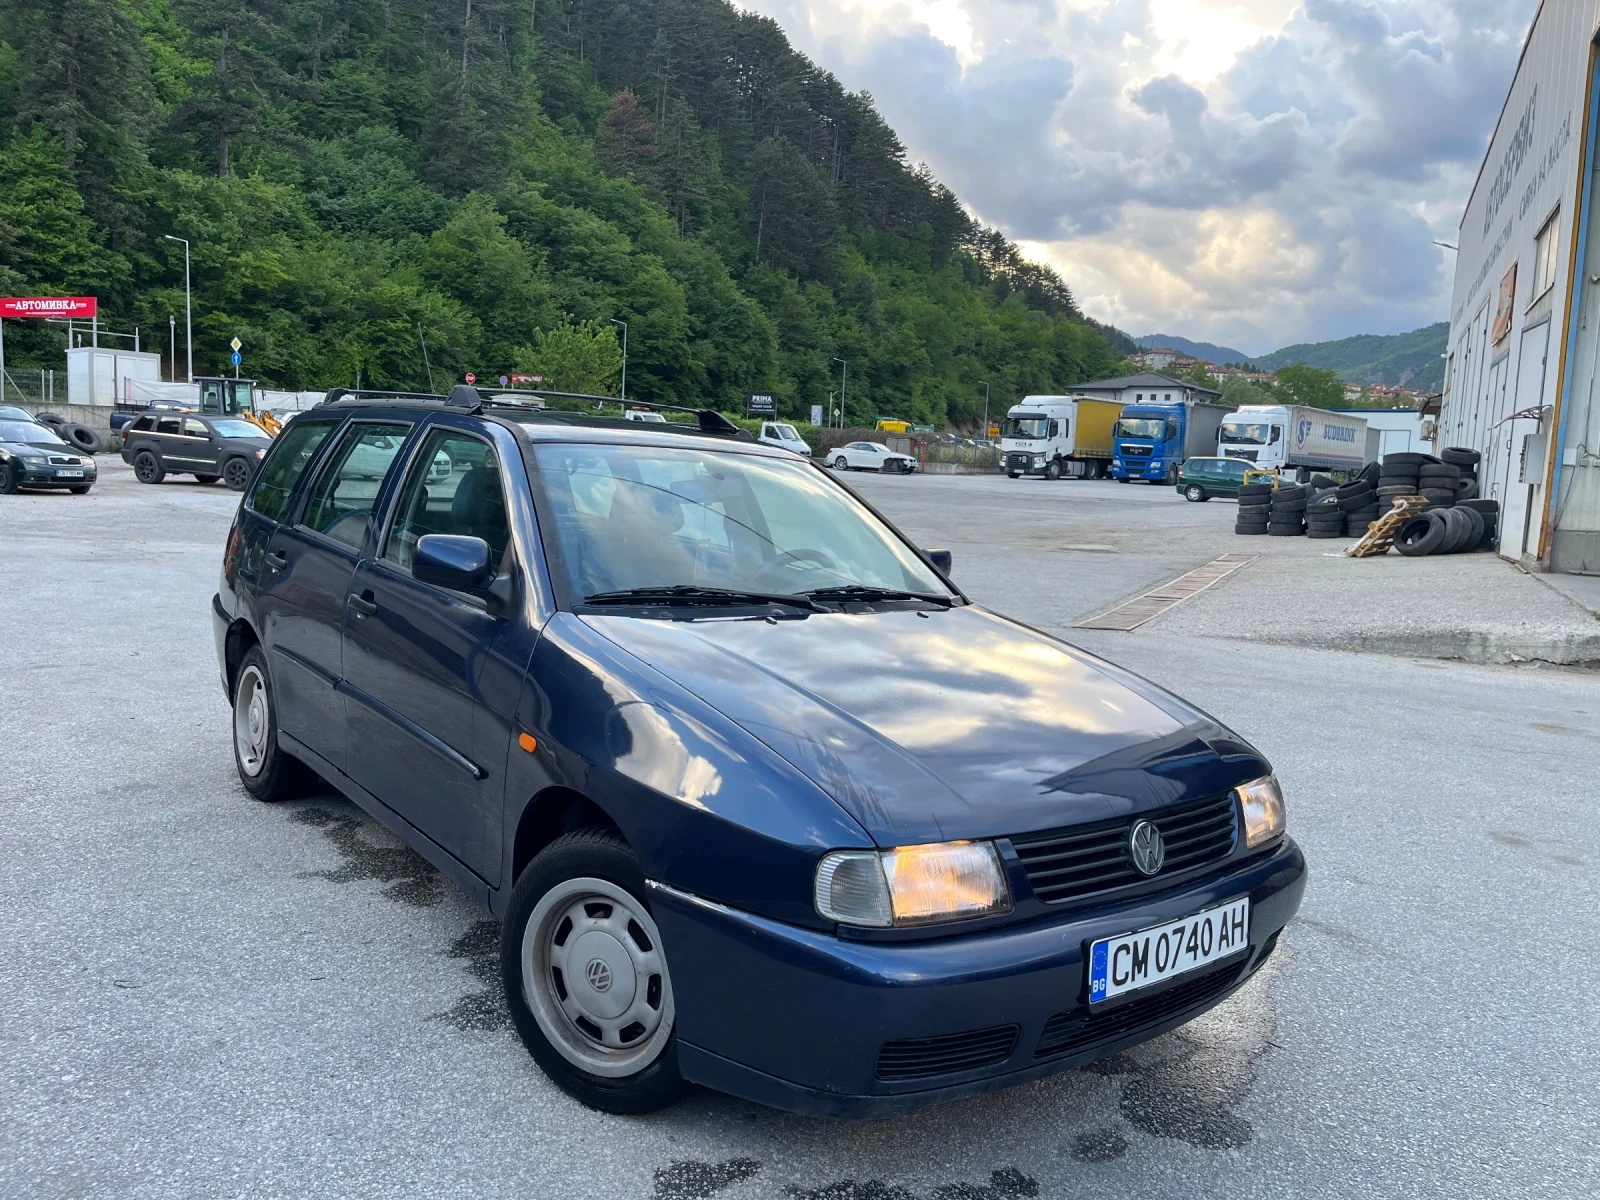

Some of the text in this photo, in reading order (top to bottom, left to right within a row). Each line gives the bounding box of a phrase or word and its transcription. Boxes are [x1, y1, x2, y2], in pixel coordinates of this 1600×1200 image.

[15, 300, 76, 310] АВТОМИВКА
[1112, 904, 1245, 987] CM 0740 AH
[1092, 977, 1106, 994] BG
